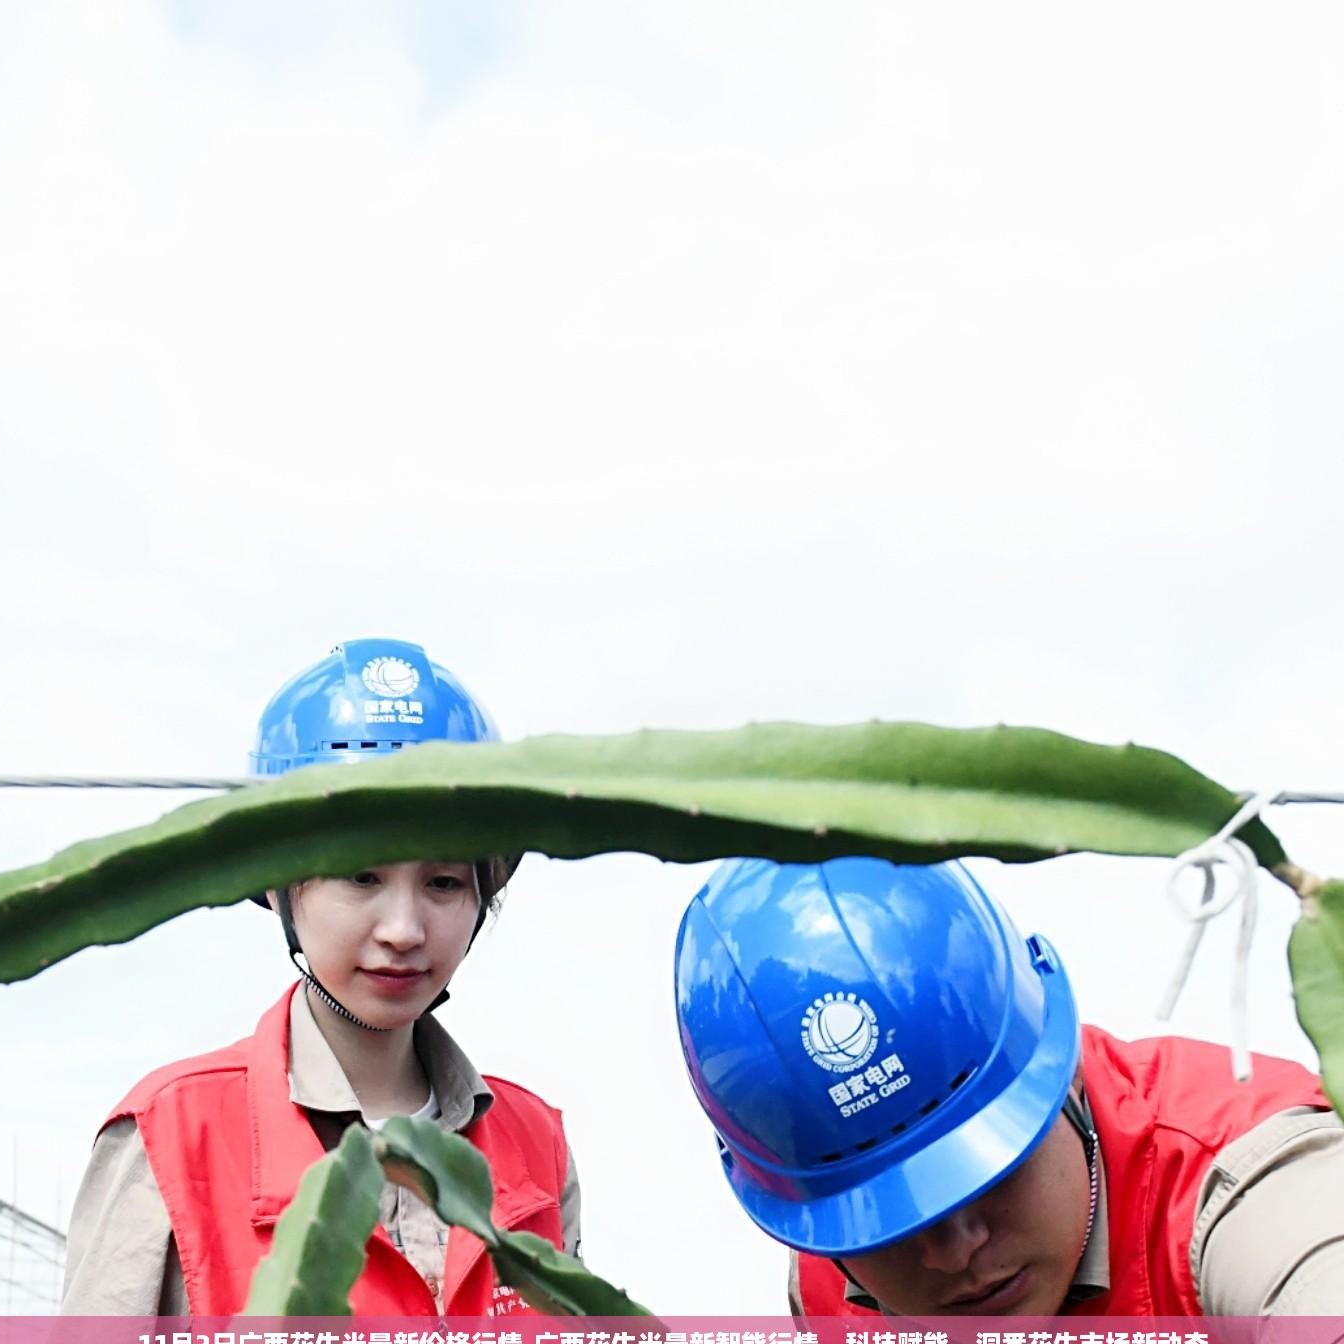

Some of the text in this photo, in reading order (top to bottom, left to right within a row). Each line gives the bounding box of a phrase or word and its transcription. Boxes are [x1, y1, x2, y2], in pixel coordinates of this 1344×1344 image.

[365, 700, 423, 715] 国家电网
[828, 1053, 905, 1106] 国家电网
[840, 1074, 911, 1118] STATE GRID
